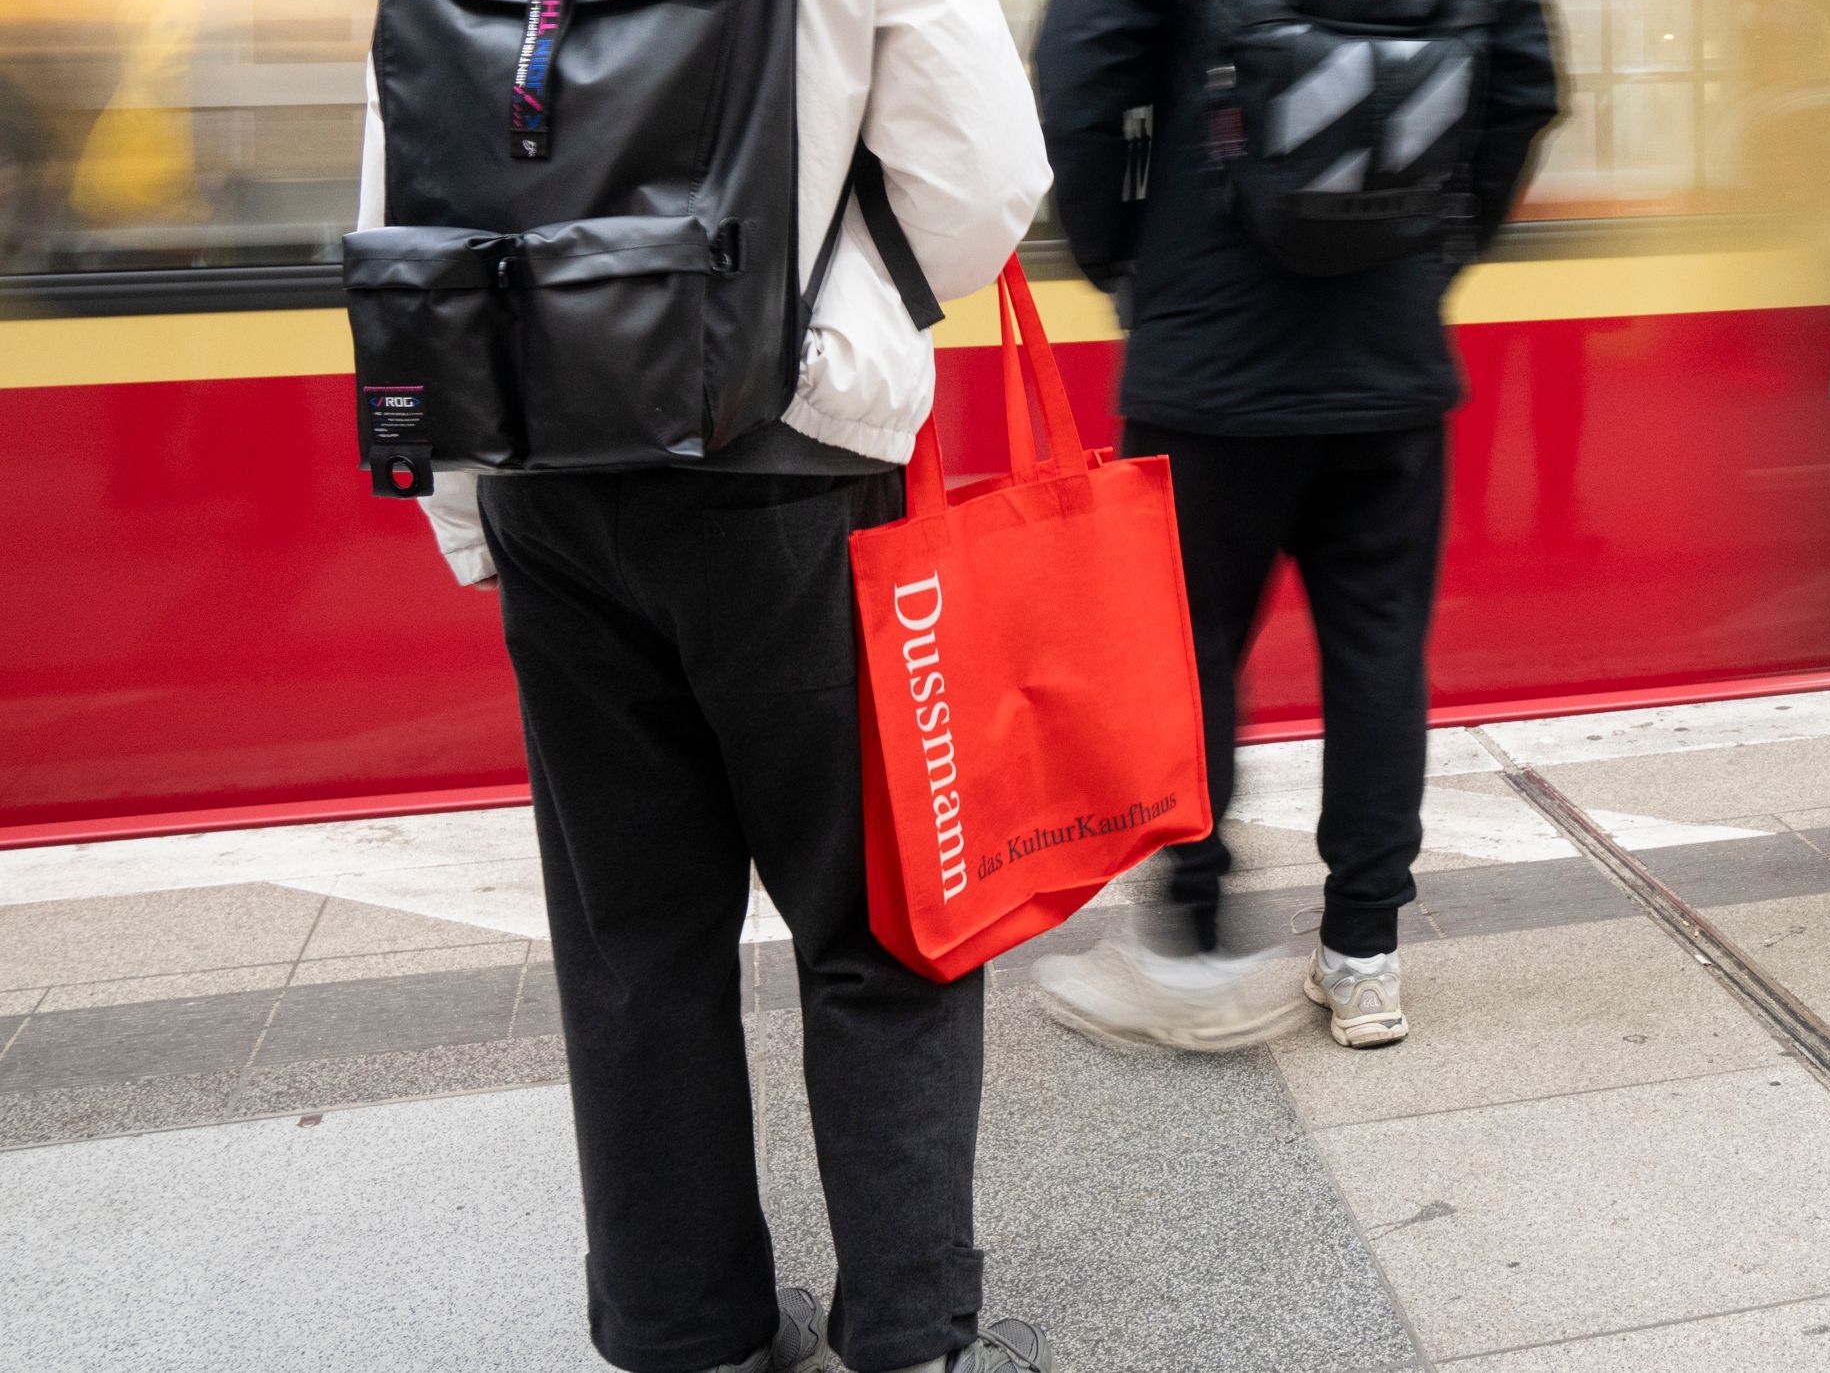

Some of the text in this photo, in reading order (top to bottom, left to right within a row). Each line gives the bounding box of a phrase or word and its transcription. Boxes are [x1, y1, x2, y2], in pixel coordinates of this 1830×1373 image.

[894, 570, 968, 905] Dussmann
[977, 792, 1177, 881] das KulturKaufhaus
